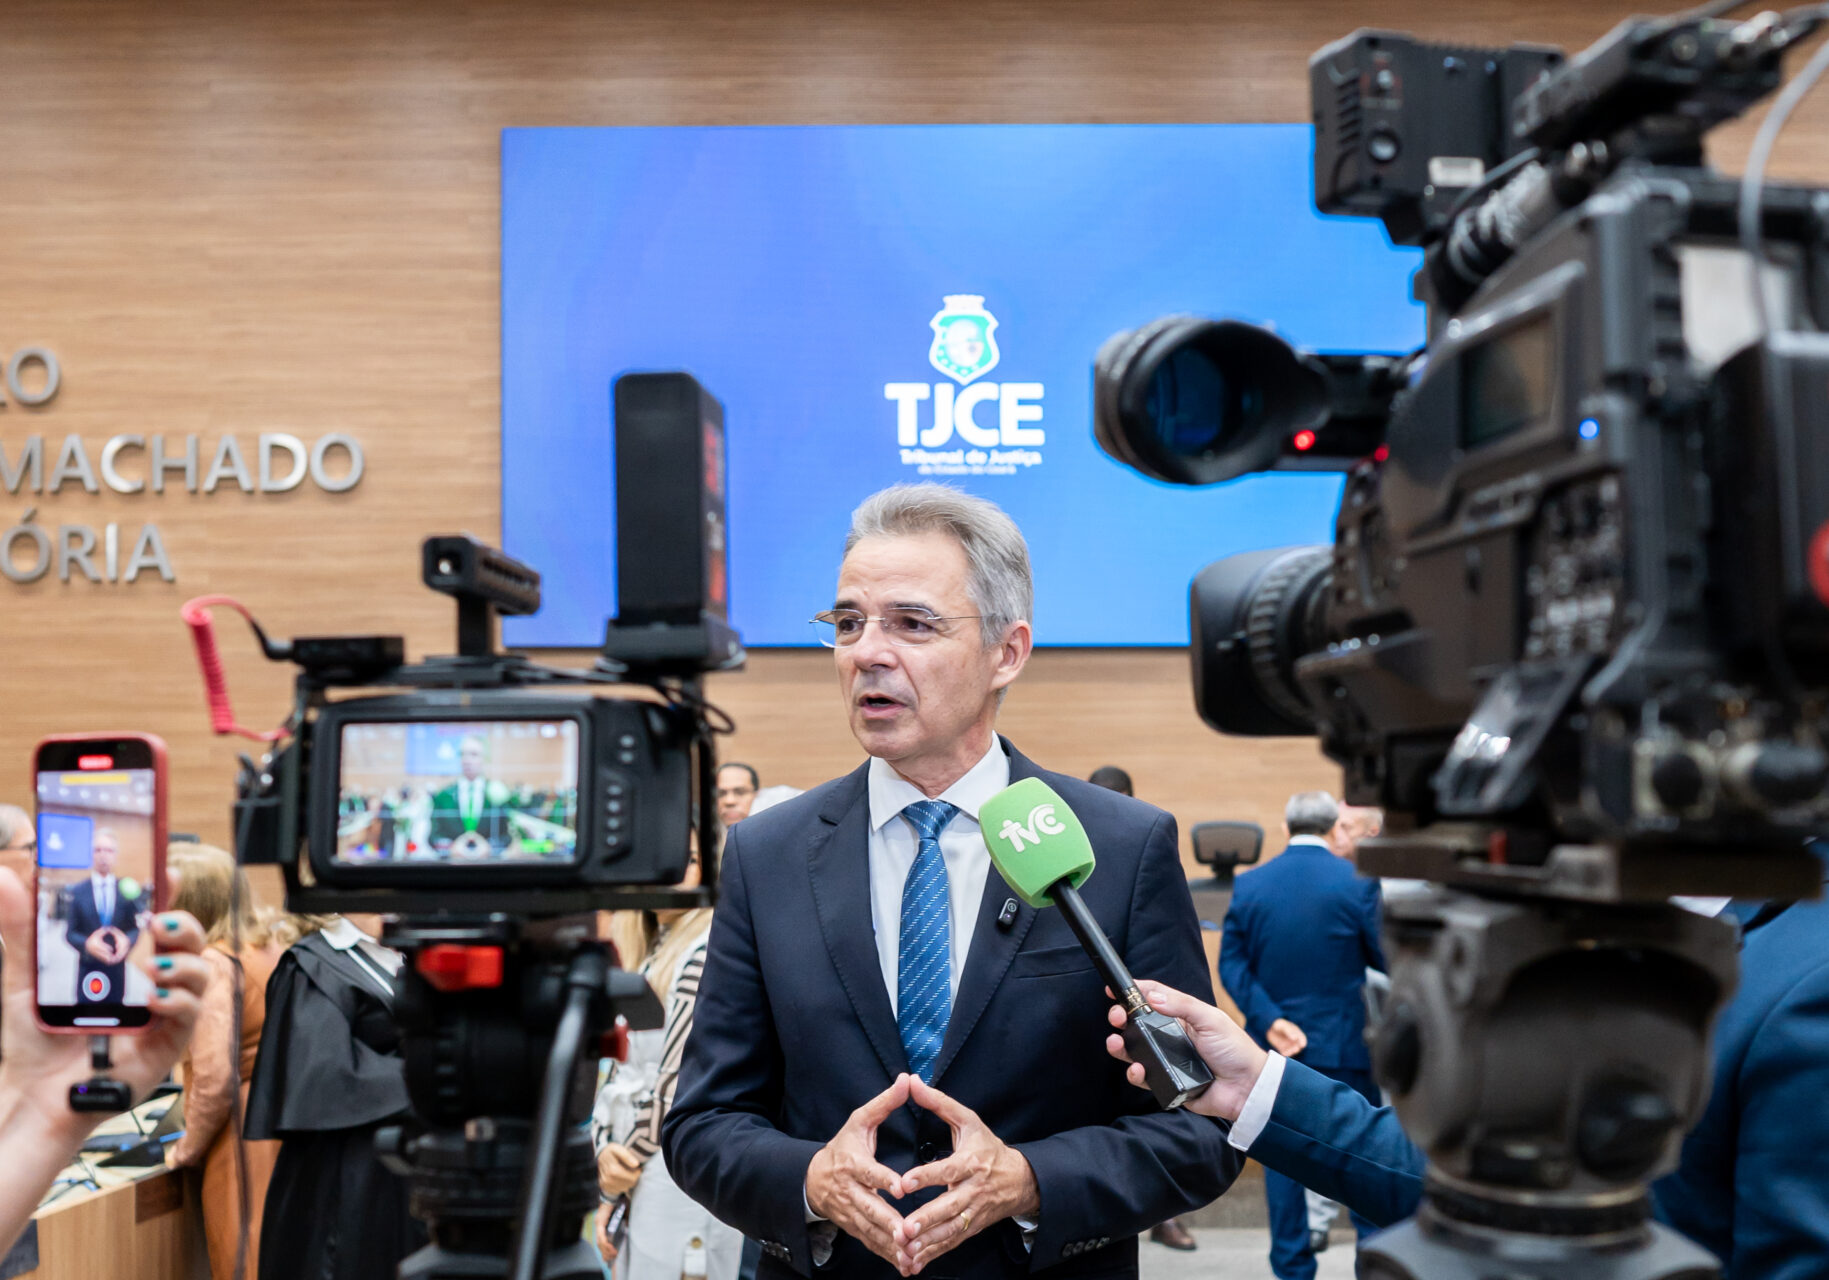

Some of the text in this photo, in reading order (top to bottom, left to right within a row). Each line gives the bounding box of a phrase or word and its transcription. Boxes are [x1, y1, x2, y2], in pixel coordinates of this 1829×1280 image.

[0, 347, 61, 406] O
[884, 381, 1045, 448] TJCE
[0, 432, 365, 494] MACHADO
